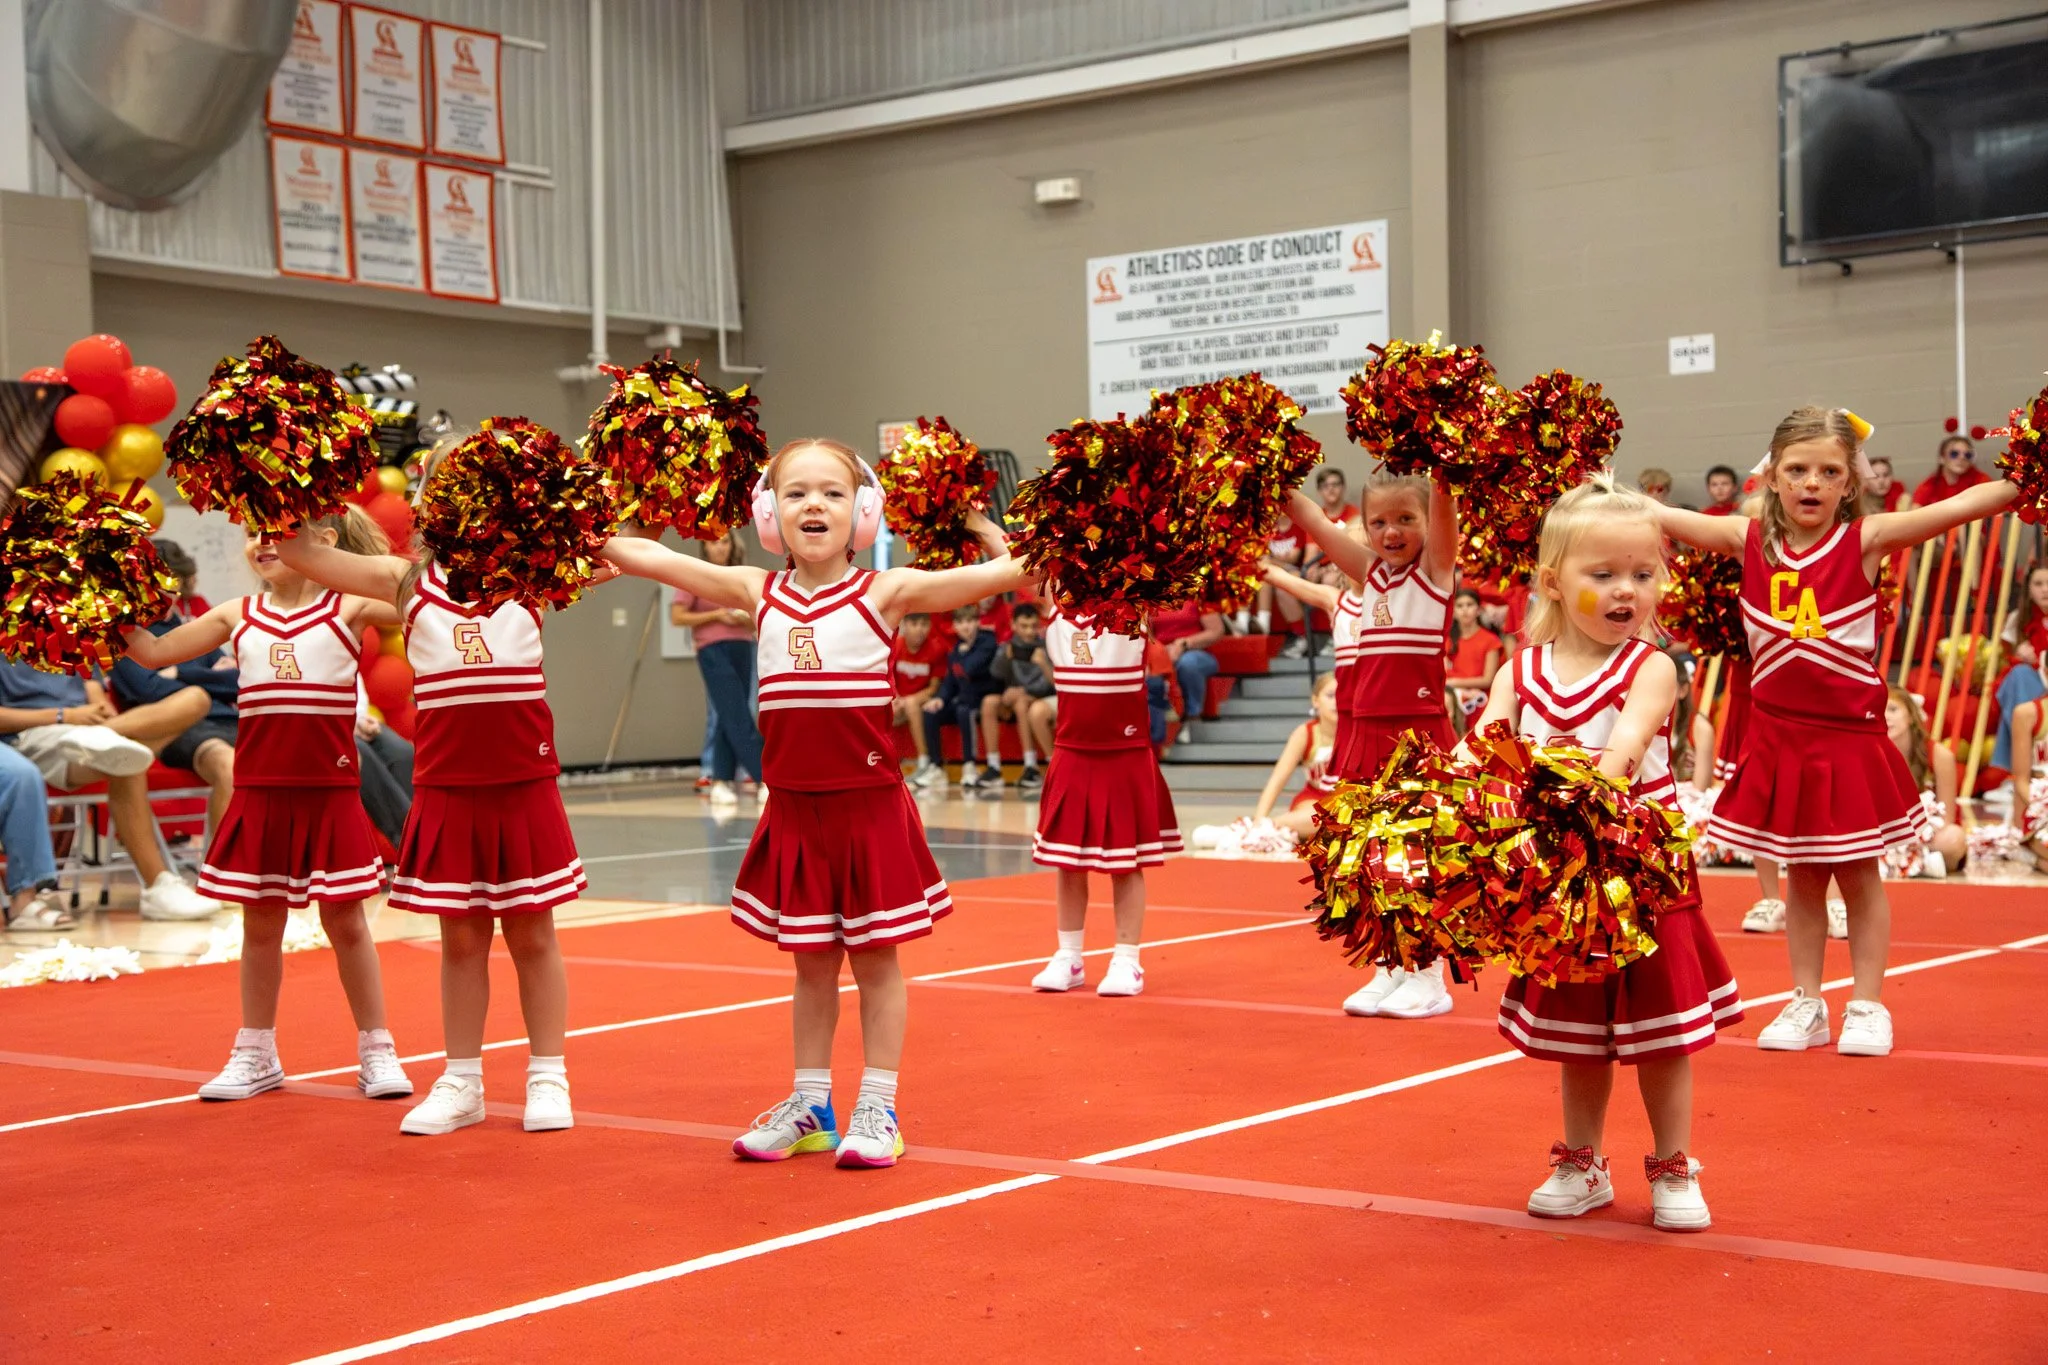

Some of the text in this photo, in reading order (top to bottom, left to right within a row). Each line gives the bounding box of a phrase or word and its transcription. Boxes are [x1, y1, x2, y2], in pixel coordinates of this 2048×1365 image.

[1127, 230, 1342, 277] ATHLETICS CODE OF CONDUCT
[1137, 341, 1175, 357] SUPPORT
[1177, 339, 1191, 352] ALL
[1234, 331, 1274, 347] COACHES
[1277, 328, 1293, 341] AND
[1296, 323, 1340, 339] OFFICIALS
[1140, 358, 1157, 370] AND
[1160, 354, 1185, 368] TRUST
[1188, 352, 1211, 365] THEIR
[1265, 345, 1281, 357] AND
[1285, 340, 1329, 355] INTEGRITY
[1139, 373, 1197, 390] PARTICIPANTS
[1277, 359, 1337, 377] ENCOURAGING
[1770, 571, 1828, 638] CA
[270, 643, 302, 680] CA
[453, 622, 493, 664] CA
[789, 627, 821, 670] CA
[1071, 632, 1093, 665] CA
